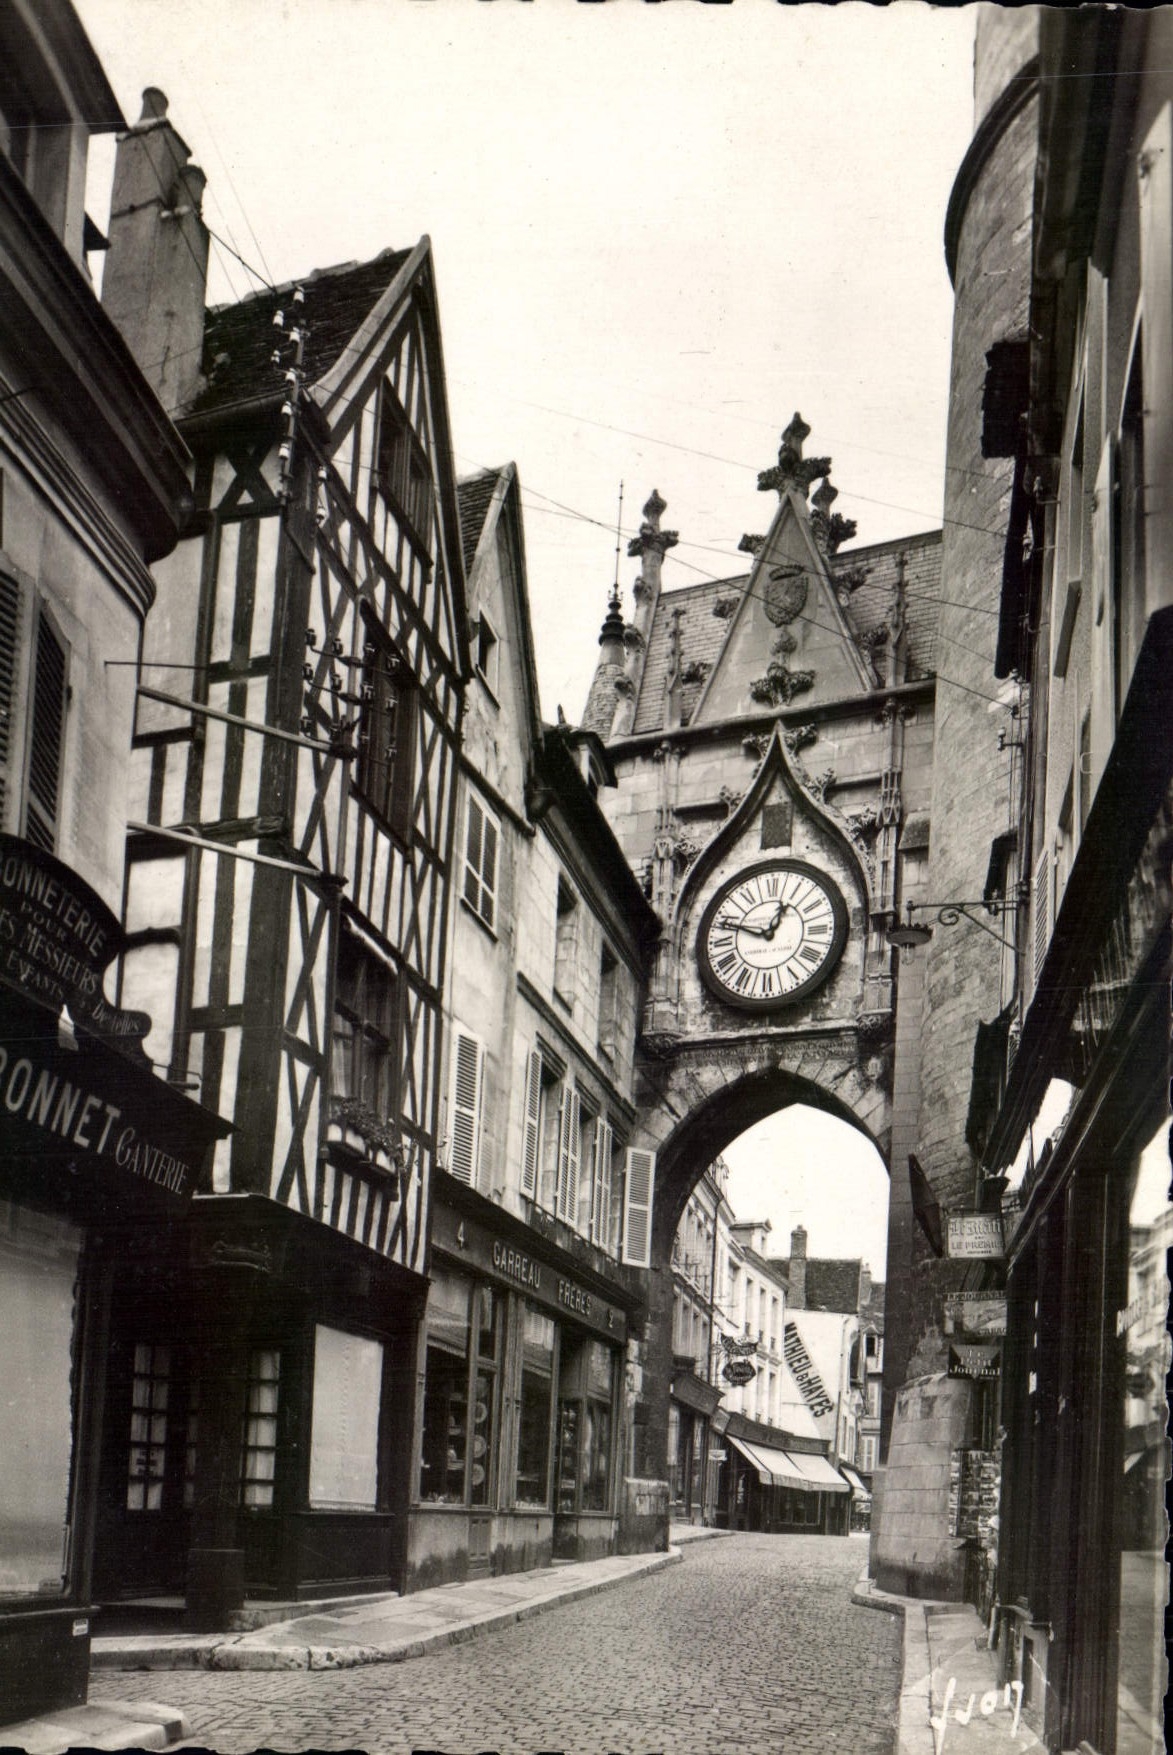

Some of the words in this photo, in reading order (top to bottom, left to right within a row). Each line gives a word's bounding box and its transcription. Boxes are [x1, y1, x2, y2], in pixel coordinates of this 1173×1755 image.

[0, 854, 106, 957] ONNETERIE
[0, 909, 18, 941] ES
[19, 922, 99, 994] MESSIEURS
[115, 1126, 190, 1194] GANTERIE
[456, 1222, 465, 1250] 4
[965, 1240, 1004, 1250] PREMIE
[493, 1241, 541, 1289] GARREAU
[962, 1290, 1006, 1301] JOURNAL
[784, 1321, 813, 1374] MATHIEU
[949, 1365, 1001, 1377] Journal
[798, 1375, 834, 1418] HAYES
